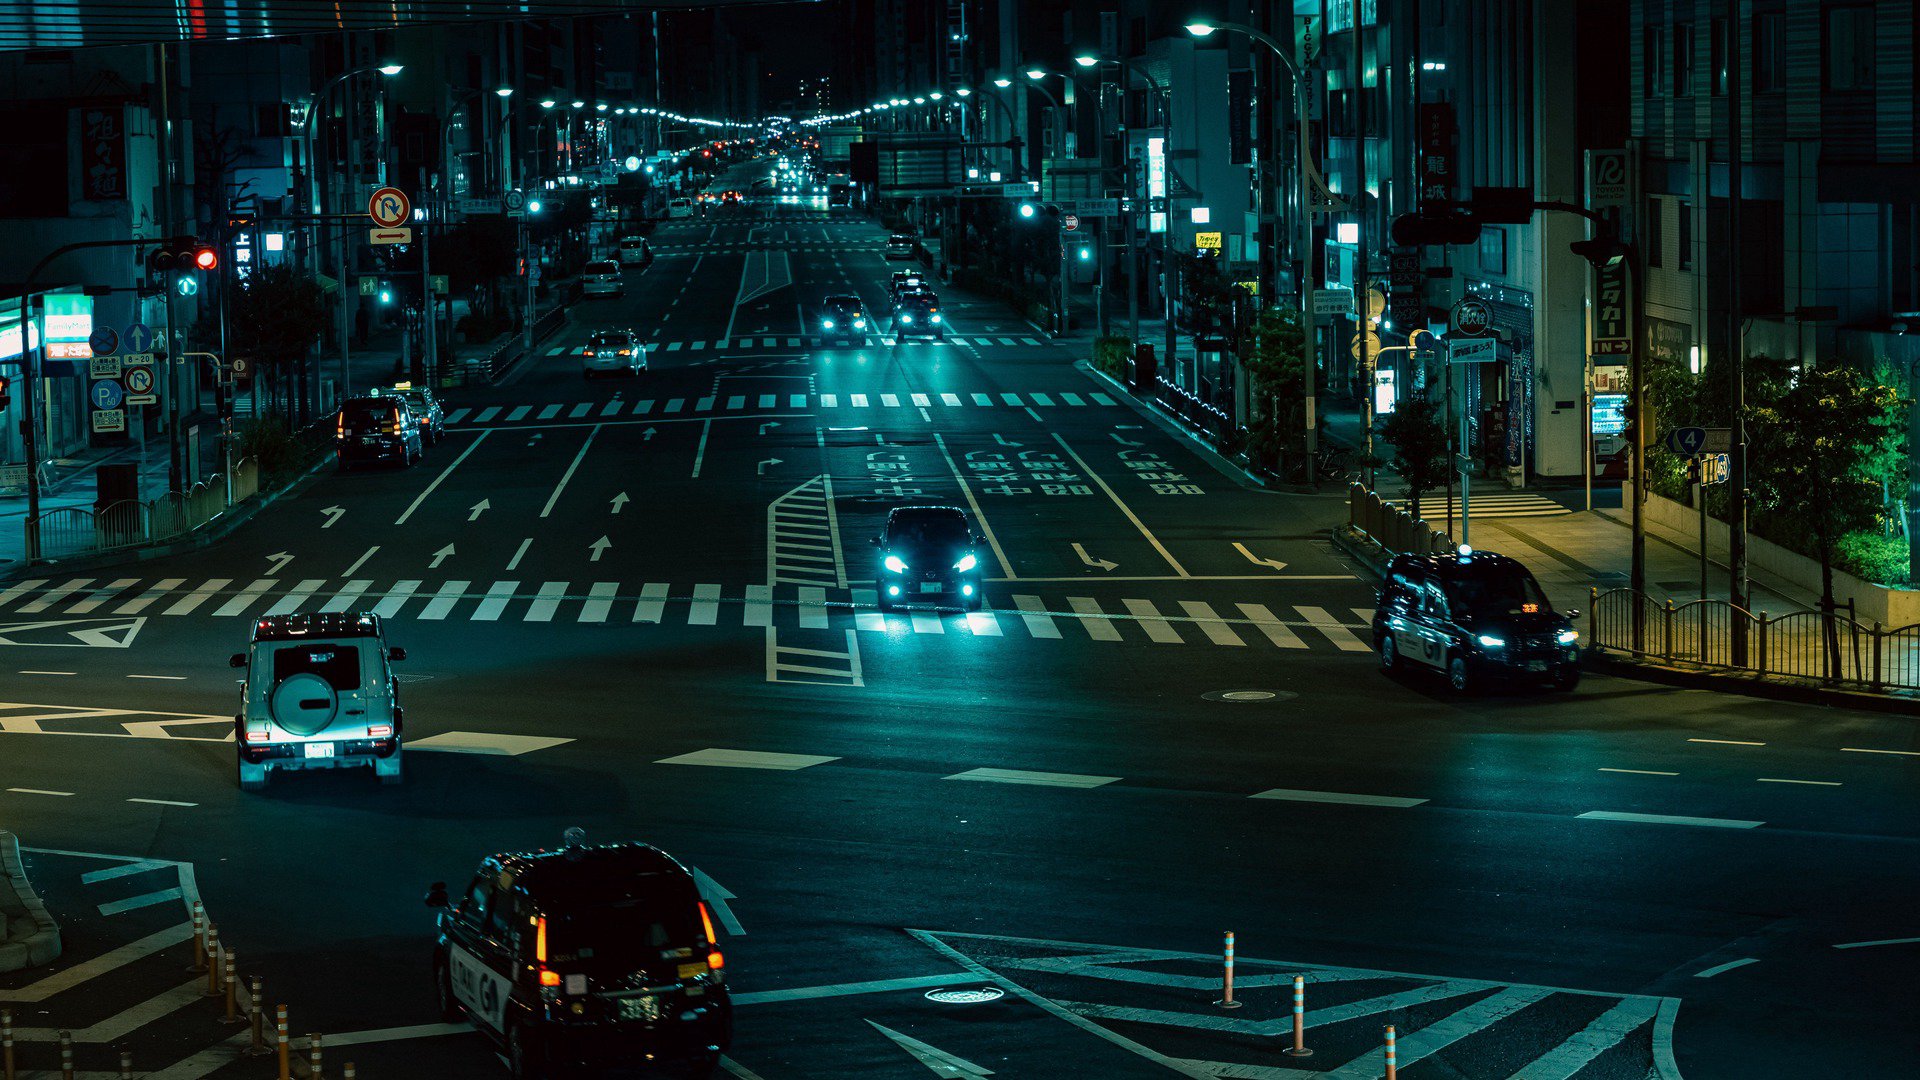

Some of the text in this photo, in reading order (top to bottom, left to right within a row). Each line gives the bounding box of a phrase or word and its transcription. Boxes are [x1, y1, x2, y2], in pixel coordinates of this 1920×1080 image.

[1425, 155, 1448, 201] 龍城
[1459, 312, 1486, 325] 消火栓
[47, 321, 91, 333] FamilyMart
[1594, 342, 1613, 354] IN
[98, 387, 110, 407] P
[1684, 430, 1698, 448] 4
